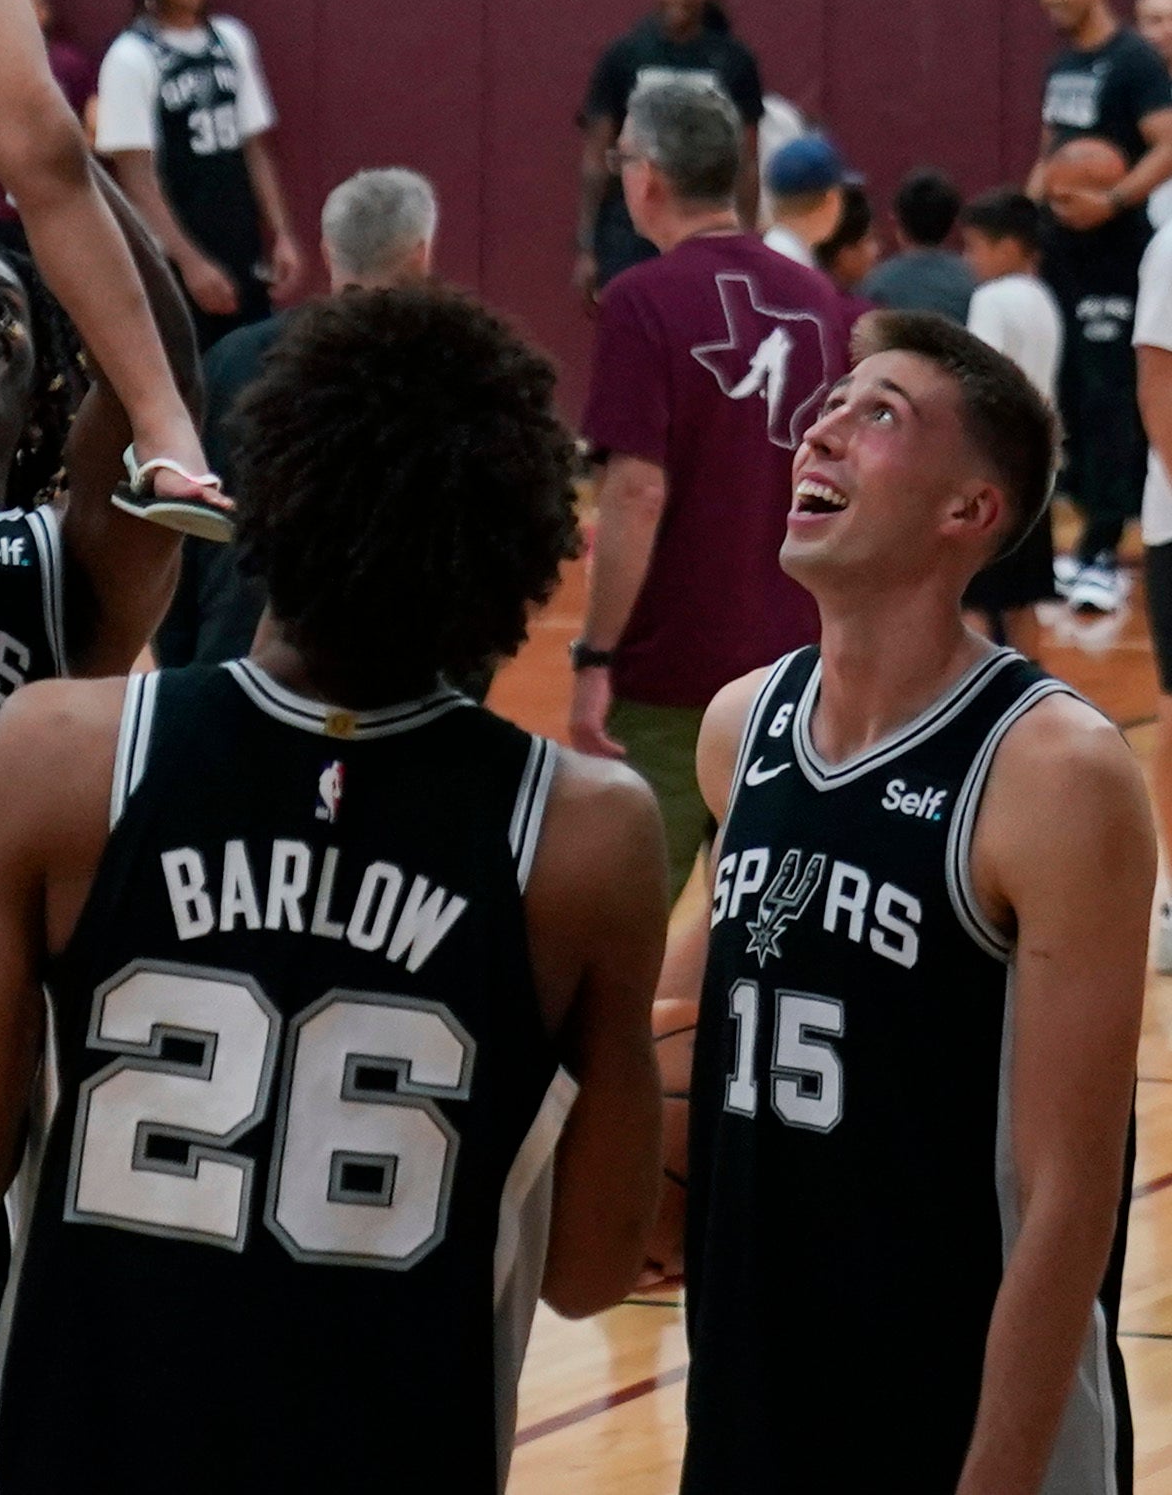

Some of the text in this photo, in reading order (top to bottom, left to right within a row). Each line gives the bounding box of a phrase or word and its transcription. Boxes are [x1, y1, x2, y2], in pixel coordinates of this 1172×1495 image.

[768, 704, 793, 738] 6
[161, 839, 468, 973] BARLOW
[63, 958, 476, 1271] 26
[723, 977, 844, 1133] 15
